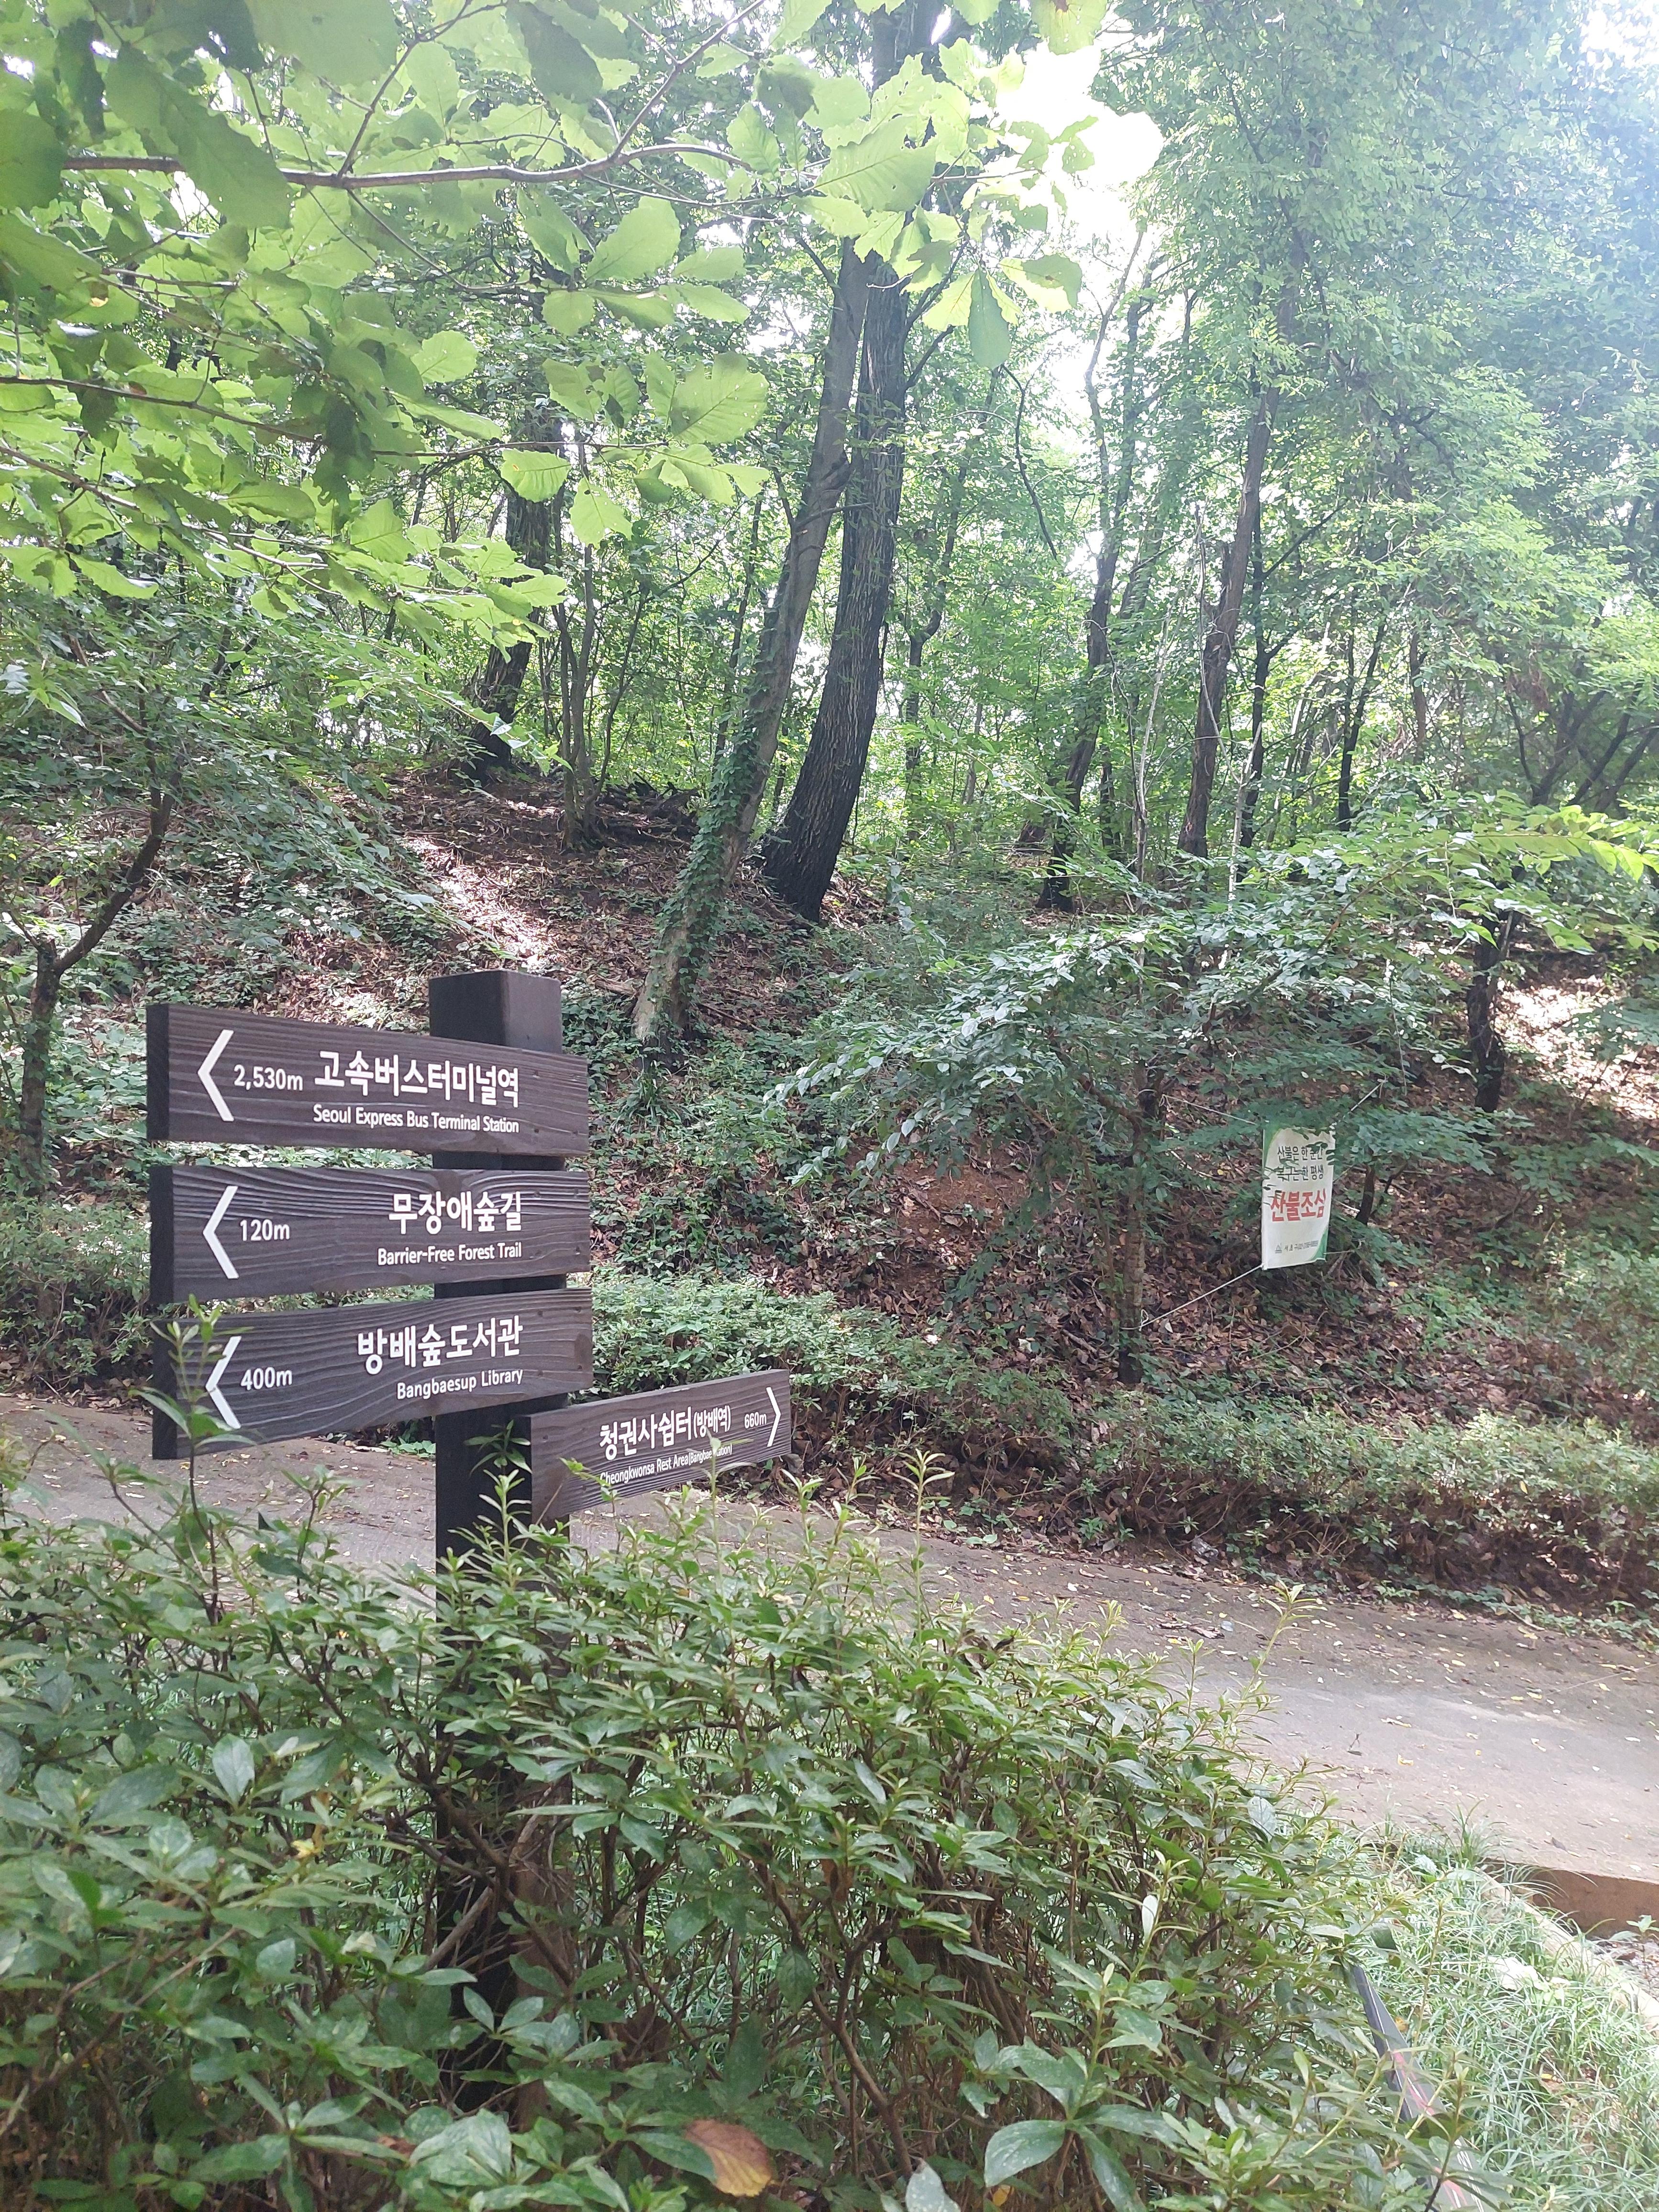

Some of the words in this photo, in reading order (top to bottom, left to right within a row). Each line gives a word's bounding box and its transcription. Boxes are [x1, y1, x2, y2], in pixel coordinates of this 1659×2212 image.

[233, 1064, 303, 1091] 2,530m
[314, 1051, 519, 1108] 고속버스터미널역
[313, 1104, 351, 1123] Seoul
[355, 1107, 404, 1128] Express
[407, 1111, 429, 1128] Bus
[431, 1112, 479, 1130] Terminal
[483, 1116, 519, 1133] Station
[240, 1219, 290, 1241] 120m
[388, 1191, 522, 1234] 무장애숲길
[1271, 1188, 1326, 1221] 산불조심
[377, 1246, 455, 1266] Barrier-Free
[458, 1244, 495, 1261] Forest
[498, 1242, 522, 1258] Trail
[241, 1367, 292, 1391] 400m
[357, 1315, 523, 1375] 방배숲도서관
[397, 1374, 476, 1400] Bangbaesup
[481, 1369, 523, 1388] Library
[744, 1412, 767, 1429] 660m
[657, 1458, 672, 1473] Rest
